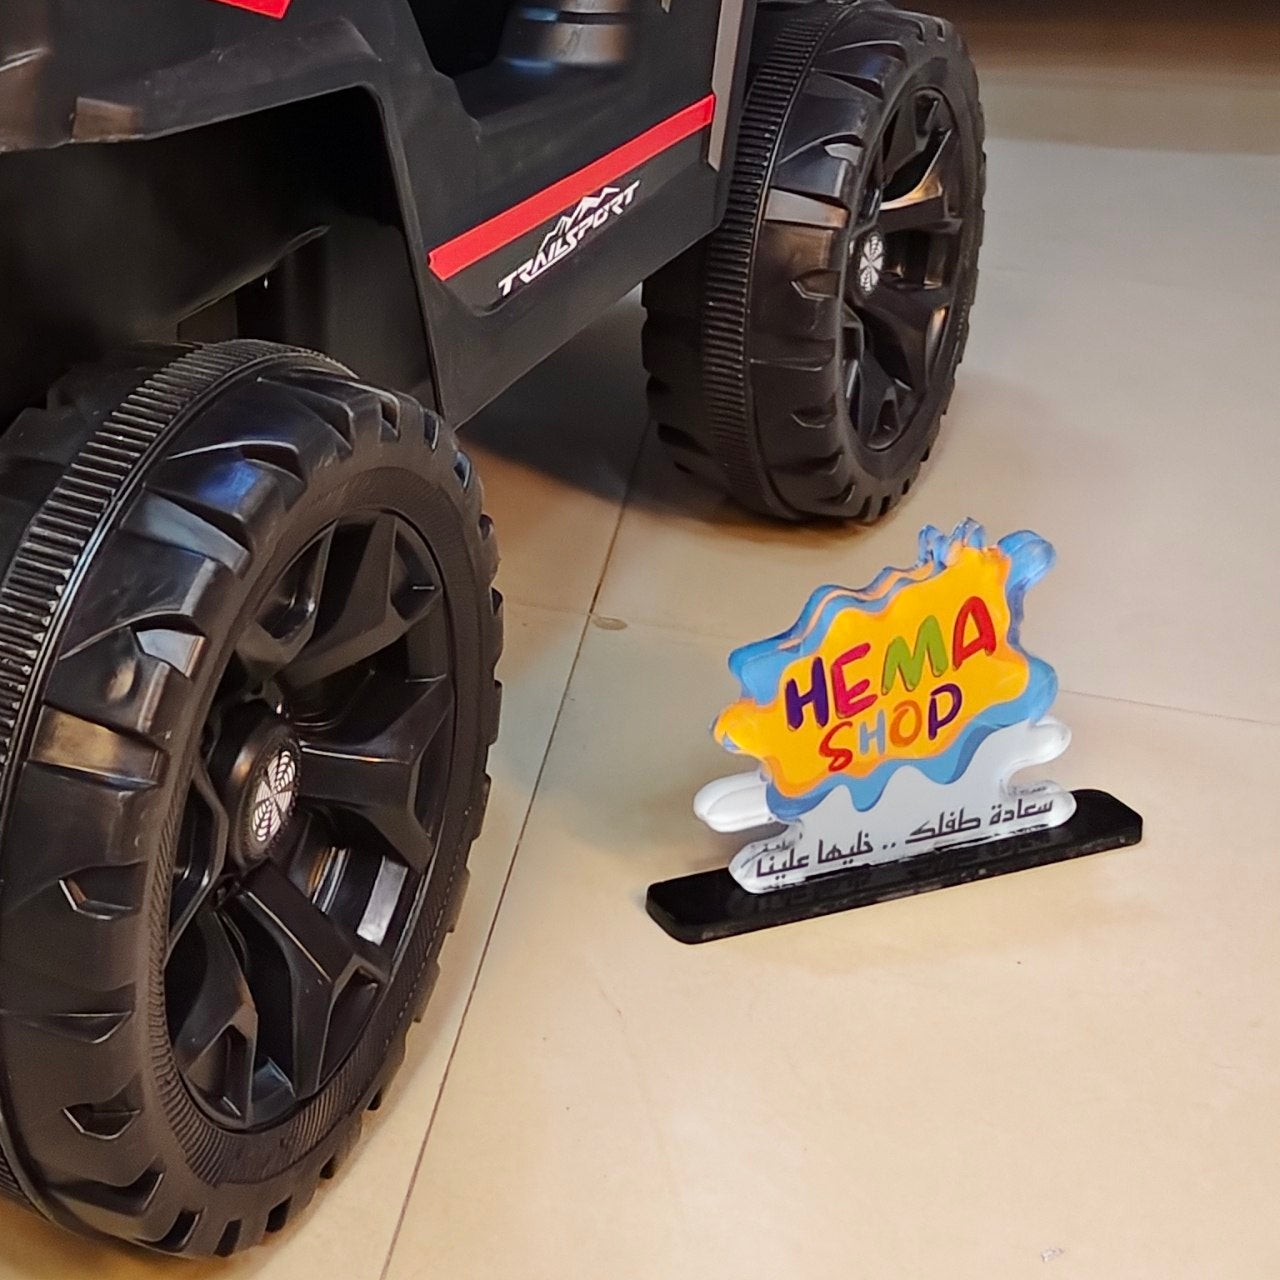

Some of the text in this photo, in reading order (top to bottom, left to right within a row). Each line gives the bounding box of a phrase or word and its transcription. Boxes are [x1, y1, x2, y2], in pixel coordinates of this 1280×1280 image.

[784, 595, 997, 732] HEMA
[818, 683, 963, 772] SHOP
[905, 807, 982, 845] طفلك
[988, 798, 1054, 826] سعادة
[756, 848, 810, 880] علينا
[817, 830, 874, 866] خليها
